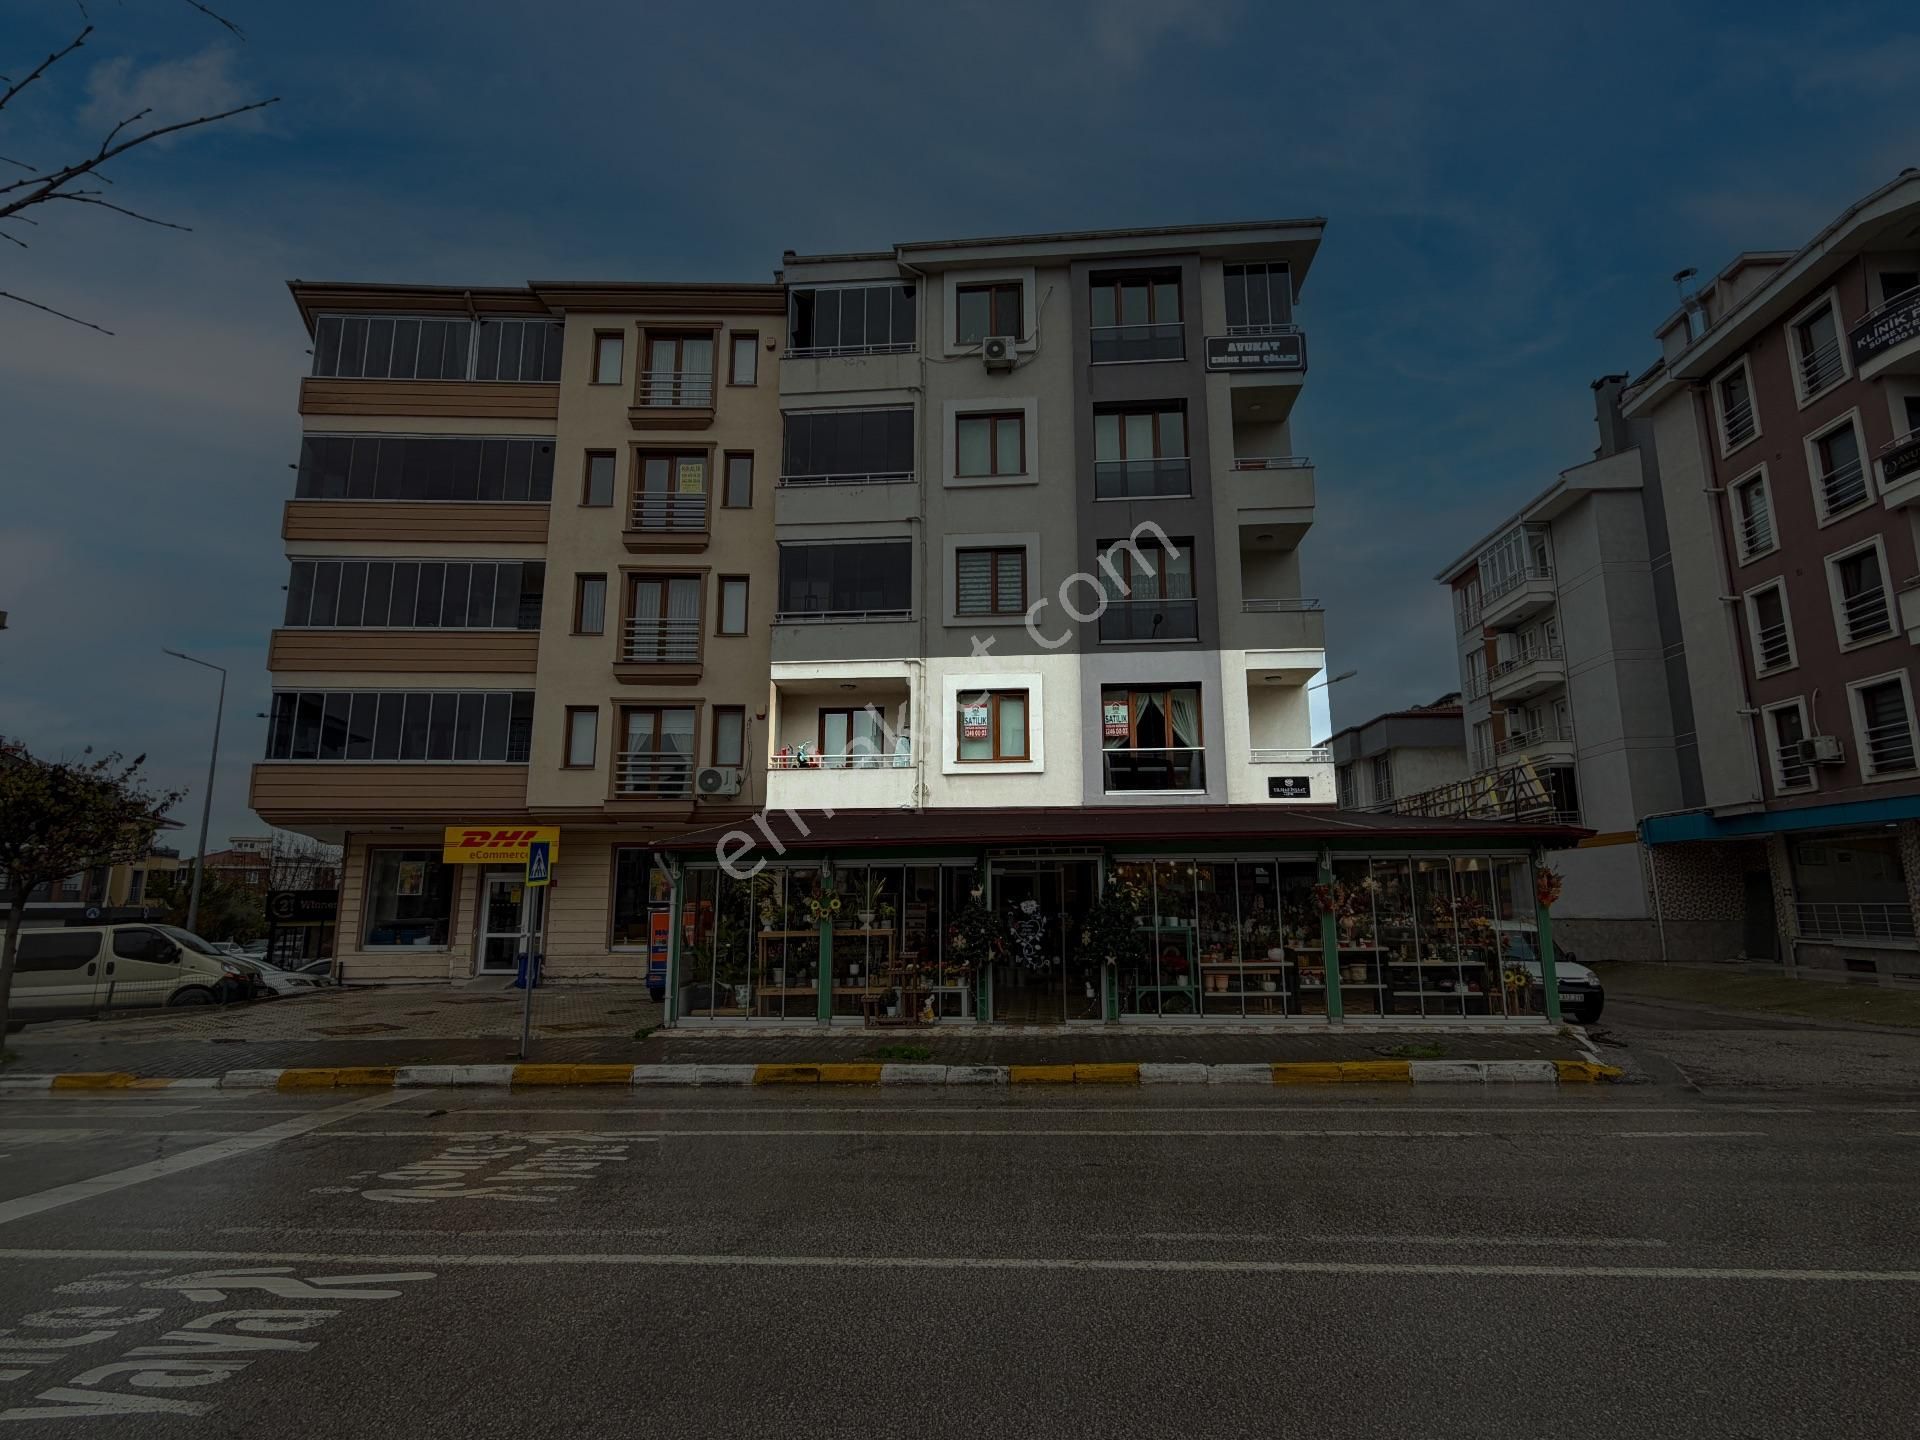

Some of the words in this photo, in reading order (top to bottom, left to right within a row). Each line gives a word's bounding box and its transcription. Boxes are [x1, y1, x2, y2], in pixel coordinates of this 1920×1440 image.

[1227, 341, 1281, 353] AVUKAT
[964, 716, 987, 725] SATILIK
[459, 831, 538, 848] DHL
[469, 850, 528, 859] eCommerc
